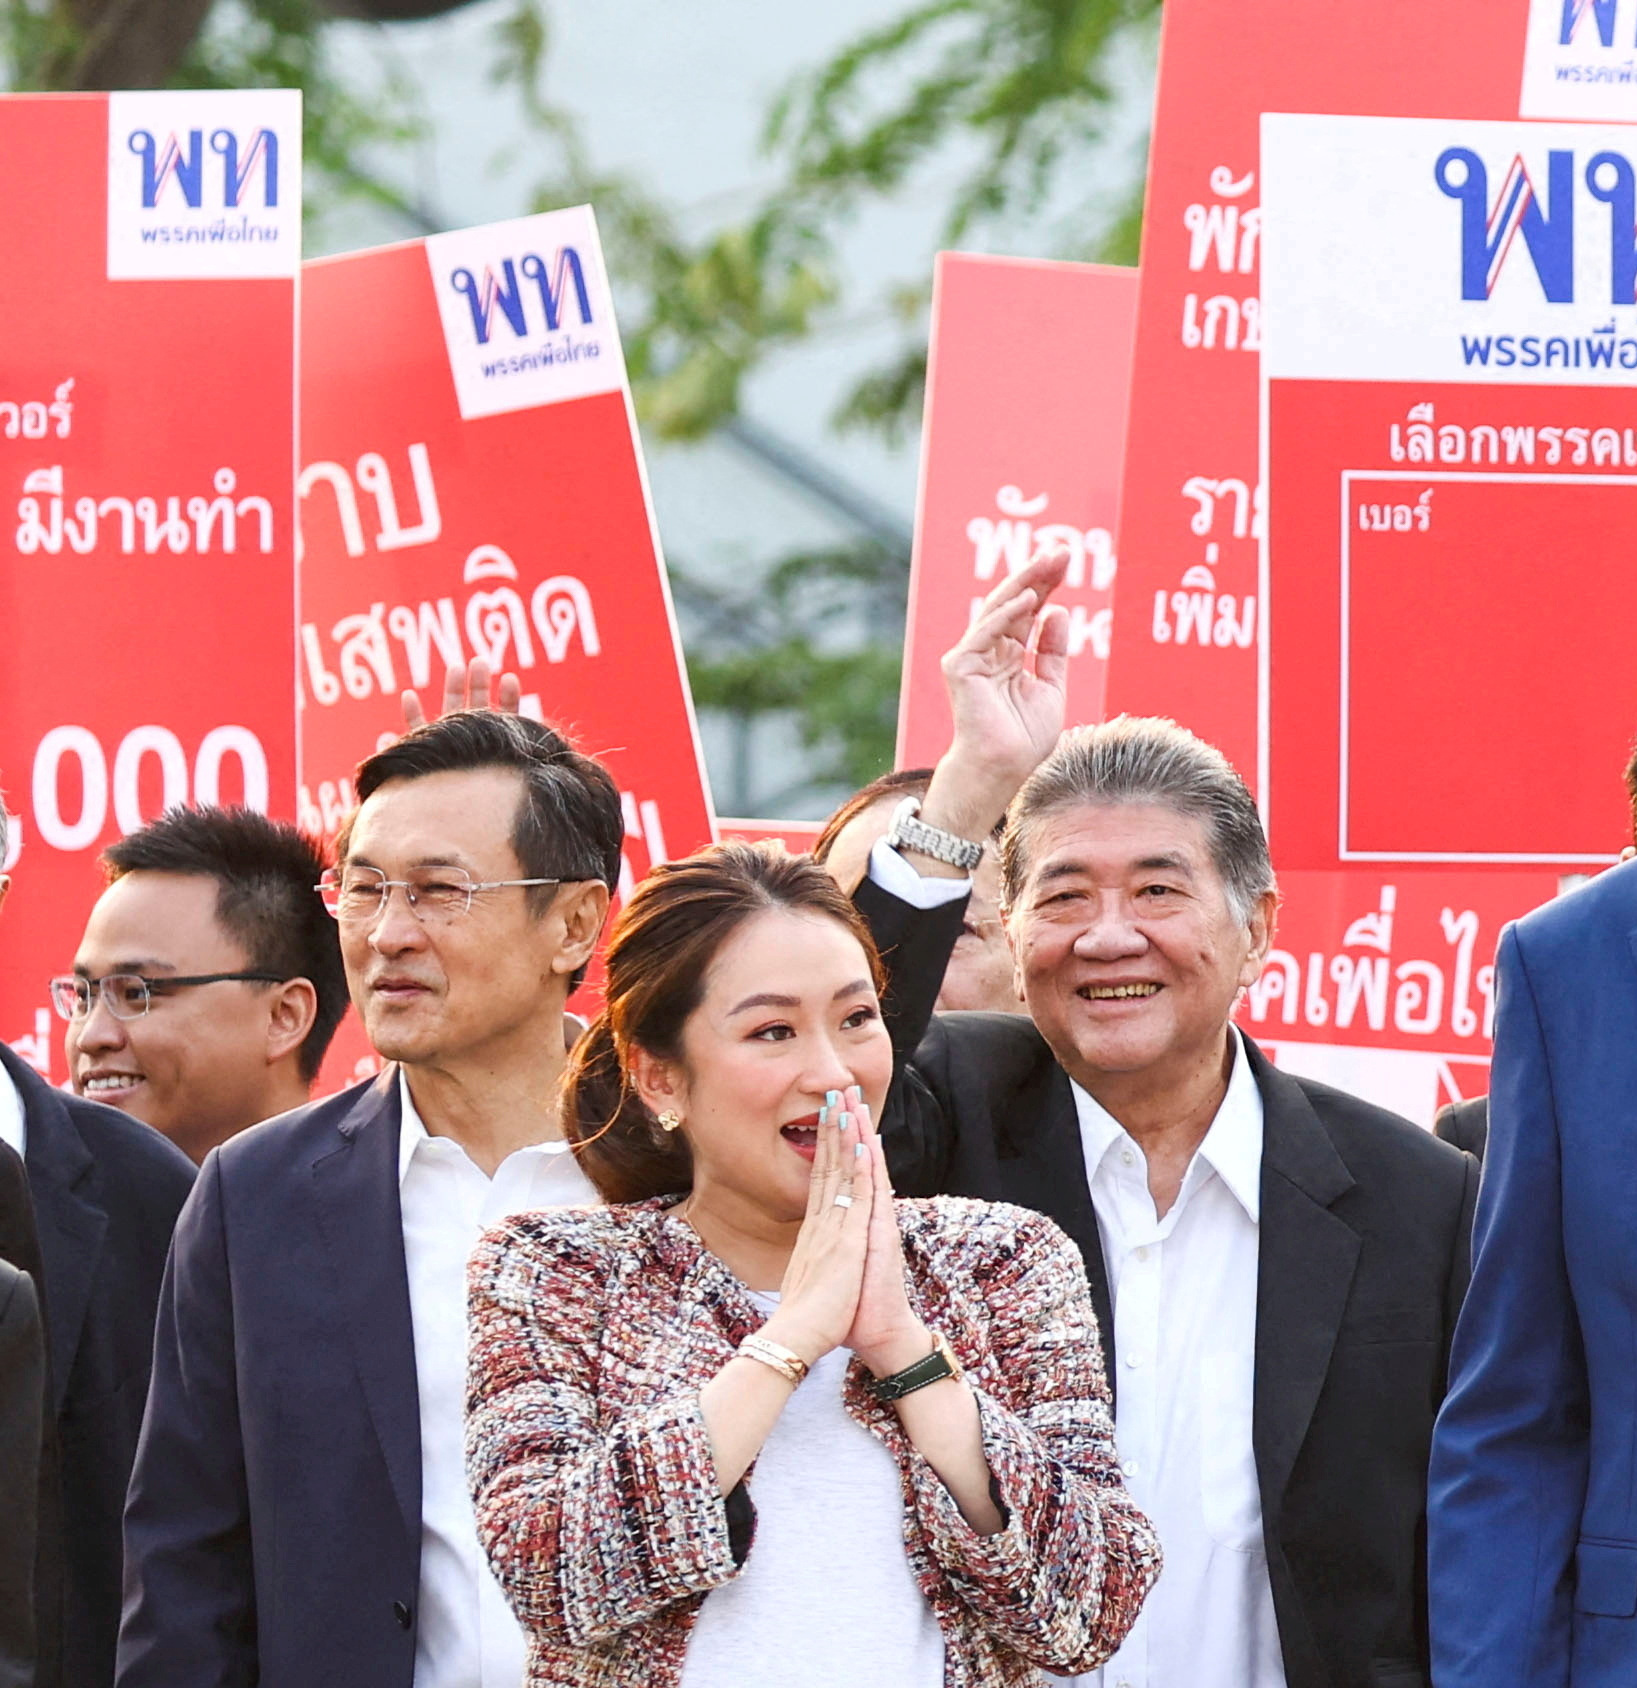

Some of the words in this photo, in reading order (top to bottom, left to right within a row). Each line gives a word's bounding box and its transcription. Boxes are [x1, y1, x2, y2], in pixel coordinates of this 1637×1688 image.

[128, 130, 278, 208] พท
[140, 221, 279, 245] พรรคเพื่อไทย
[451, 248, 592, 344] พท
[16, 466, 272, 554] มีงานทำ
[298, 444, 442, 558] าบ
[1360, 488, 1433, 531] เบอร์
[300, 545, 601, 706] เสพติด
